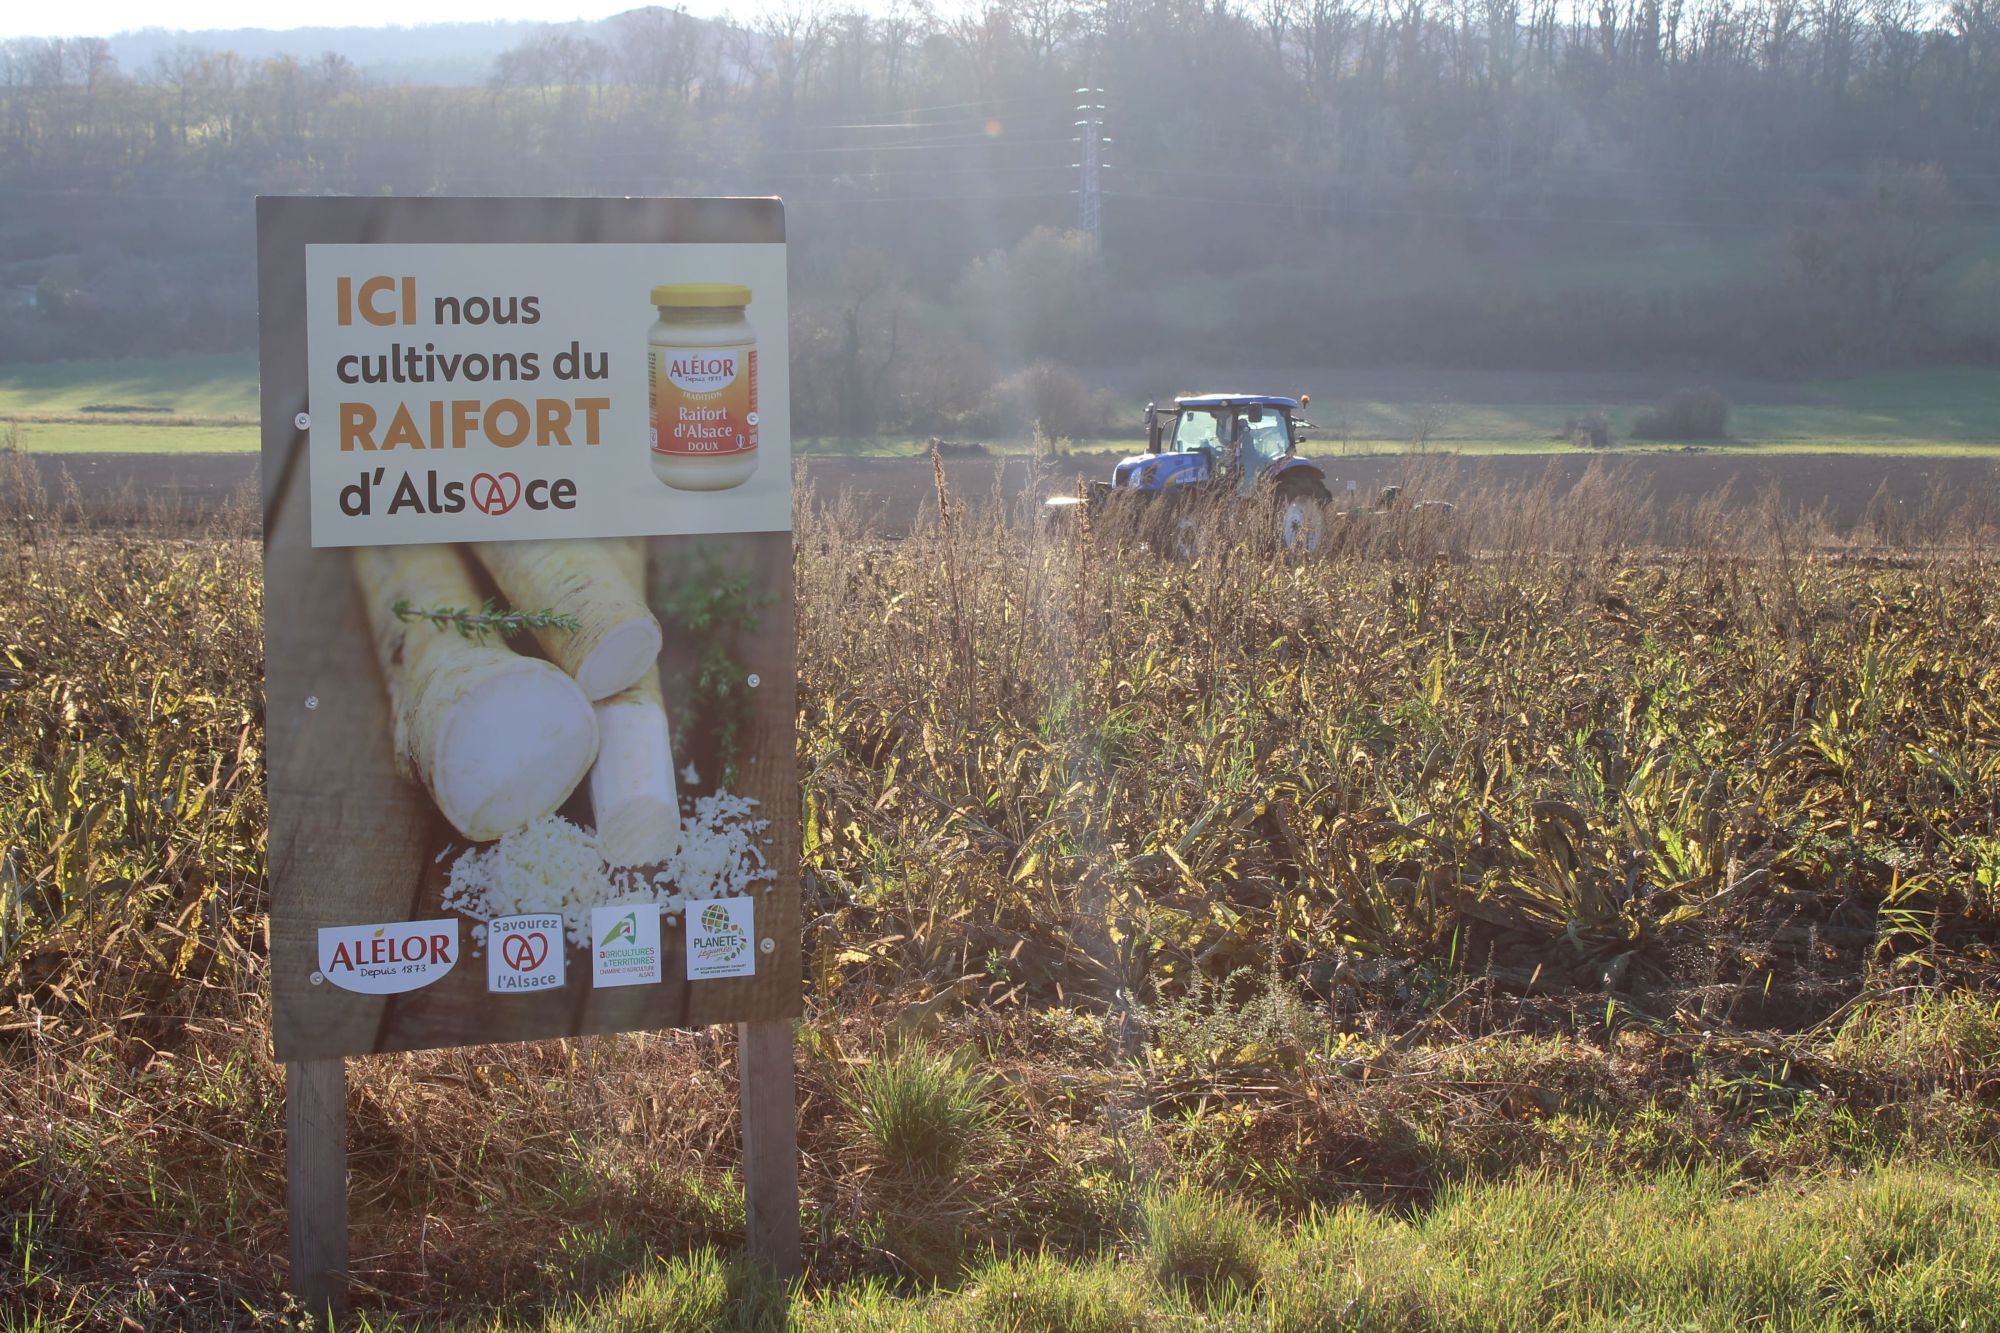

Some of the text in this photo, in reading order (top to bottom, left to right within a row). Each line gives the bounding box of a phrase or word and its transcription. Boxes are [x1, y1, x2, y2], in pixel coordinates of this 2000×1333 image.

[336, 276, 541, 326] ICI nous
[335, 342, 541, 384] cultivons
[552, 341, 609, 380] du
[679, 406, 728, 421] Raifort
[339, 397, 611, 452] RAIFORT
[673, 423, 733, 438] d'Alsace
[687, 441, 719, 451] DOUX
[493, 918, 558, 933] Savourez
[328, 927, 452, 973] ALÉLOR
[360, 964, 427, 979] Depuis 1873
[497, 972, 556, 989] l'Alsace
